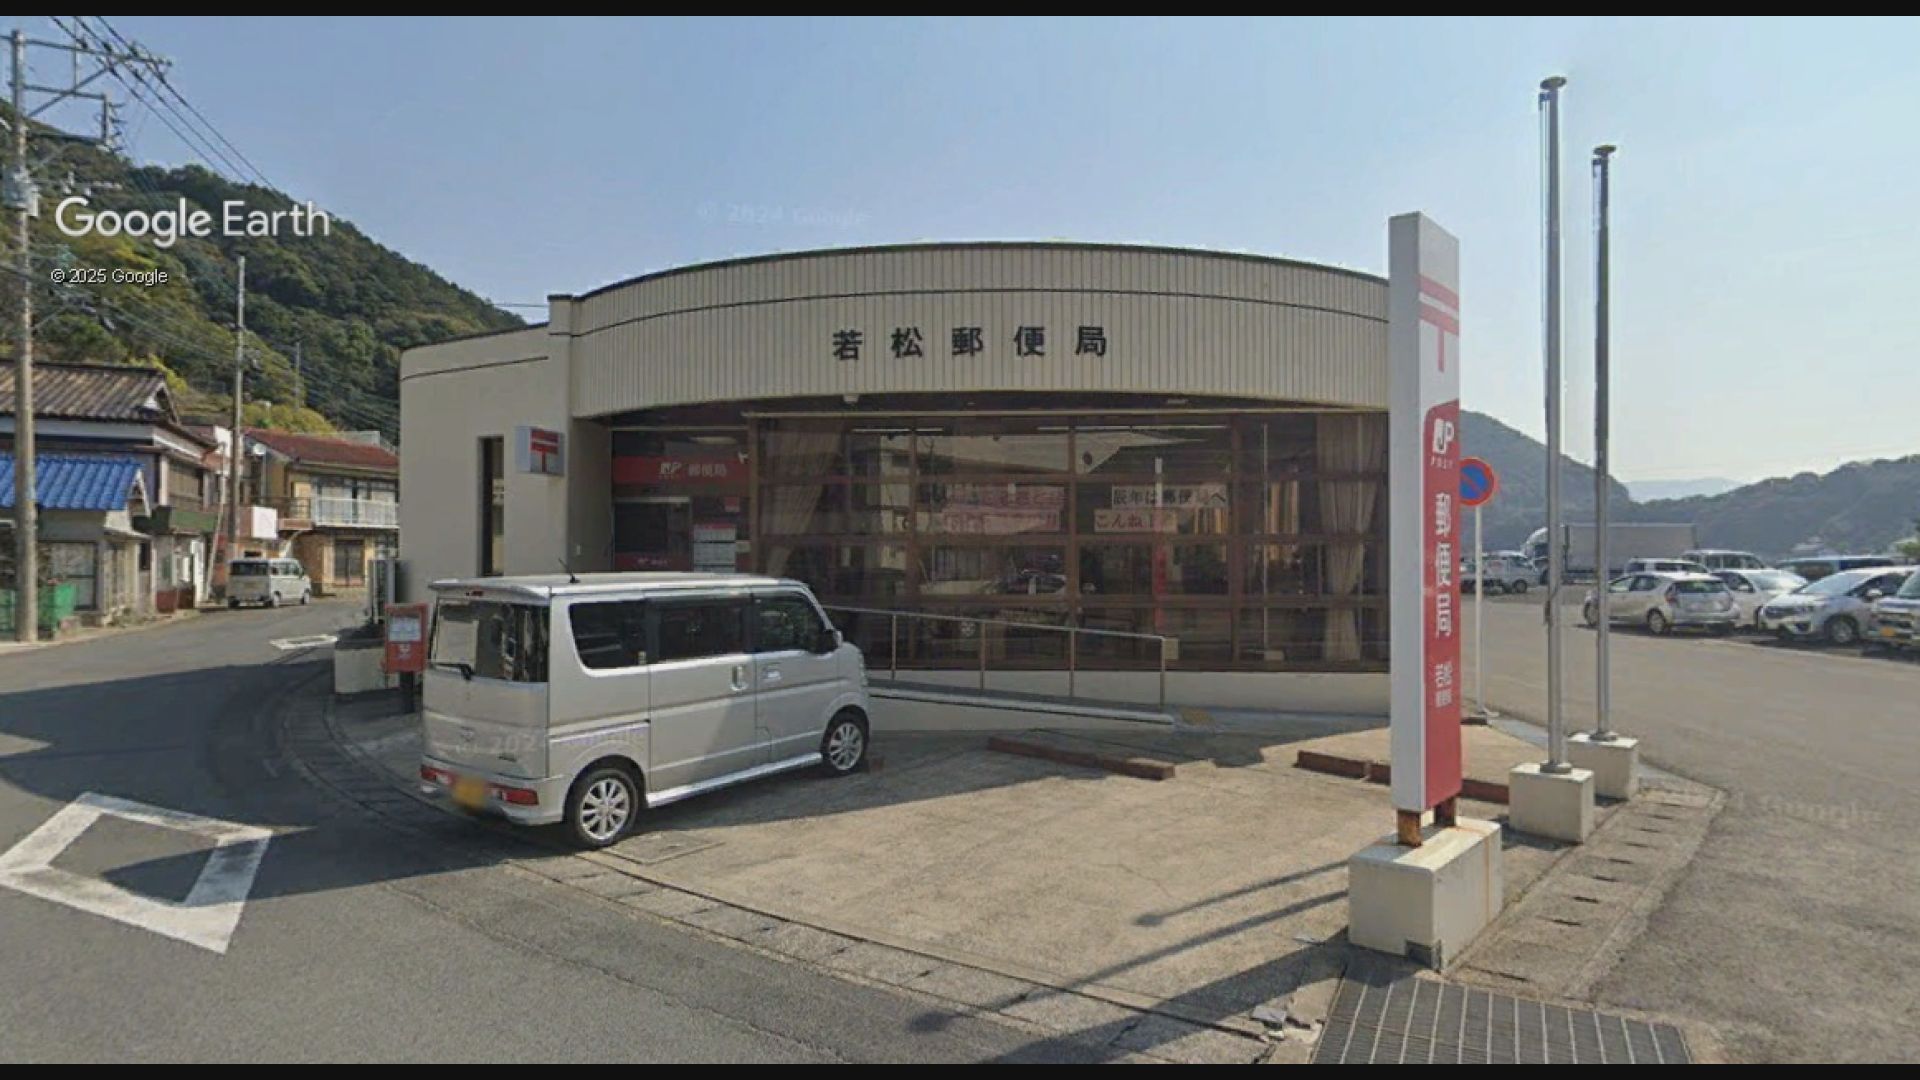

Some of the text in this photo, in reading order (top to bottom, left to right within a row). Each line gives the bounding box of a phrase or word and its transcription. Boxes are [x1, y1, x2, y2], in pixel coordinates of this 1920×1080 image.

[832, 325, 1107, 361] 若松郵便局
[1434, 491, 1453, 640] 郵便局
